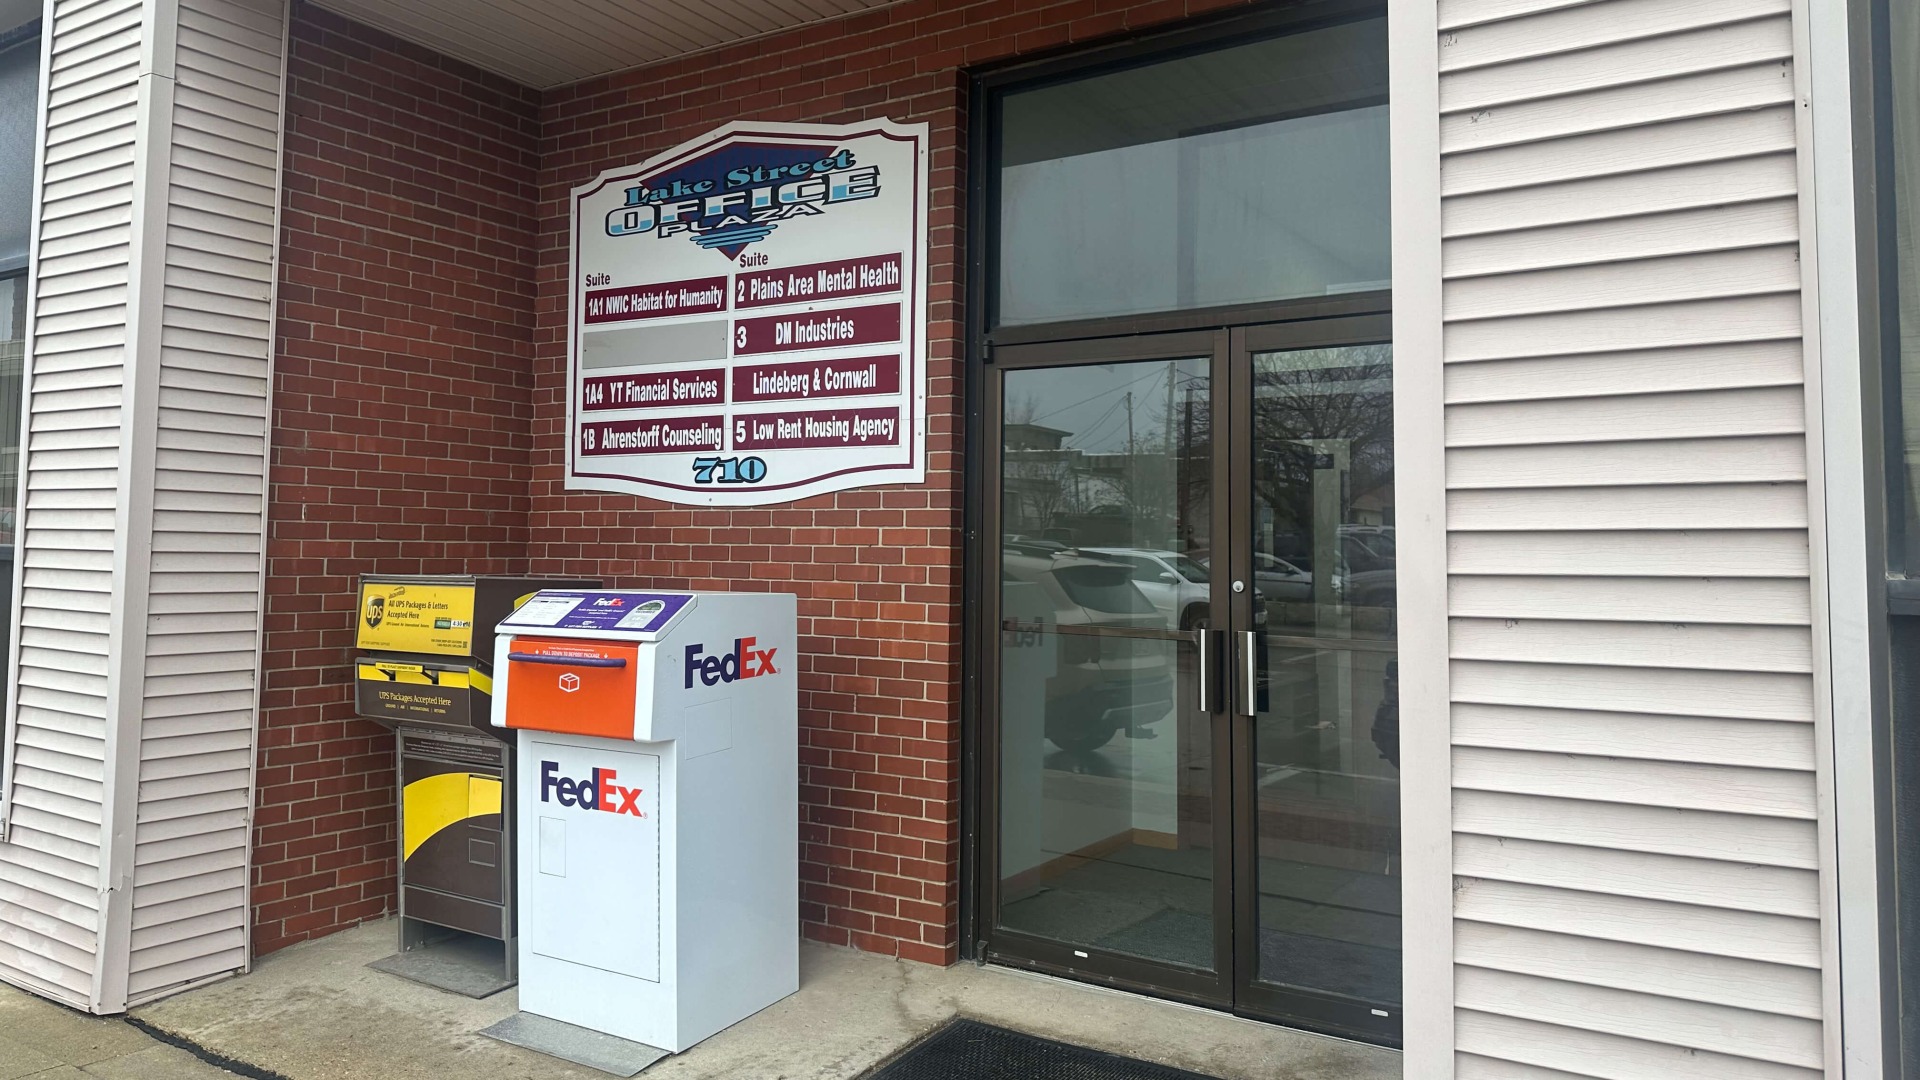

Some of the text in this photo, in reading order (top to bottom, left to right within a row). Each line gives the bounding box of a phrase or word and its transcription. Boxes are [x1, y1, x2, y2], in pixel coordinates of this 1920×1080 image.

[624, 149, 857, 206] Lake Street
[605, 165, 881, 237] OFFICE
[657, 202, 826, 239] PLAZA
[739, 252, 769, 268] Suite
[585, 273, 611, 287] Suite
[737, 260, 899, 302] 2 Plains Area Mental Health
[588, 285, 723, 316] 1A1 NWIC Habitat for Humanity
[736, 315, 855, 348] 3 DM Industries
[585, 376, 718, 405] 1A4 YT Financial Services
[753, 363, 877, 396] Lindeberg & Cornwall
[583, 422, 722, 450] 1B Ahrenstorff Counseling
[735, 414, 895, 443] 5 Low Rent Housing Agency
[692, 456, 767, 484] 710
[367, 605, 383, 624] ups
[387, 610, 420, 619] Accepted Here
[396, 600, 405, 608] UPS
[405, 601, 427, 610] Packages
[432, 602, 448, 610] Letters
[593, 597, 625, 607] FedEx
[685, 636, 778, 689] FedEx
[379, 691, 452, 706] UPS Packages Accepted Here
[540, 759, 644, 818] FedEx
